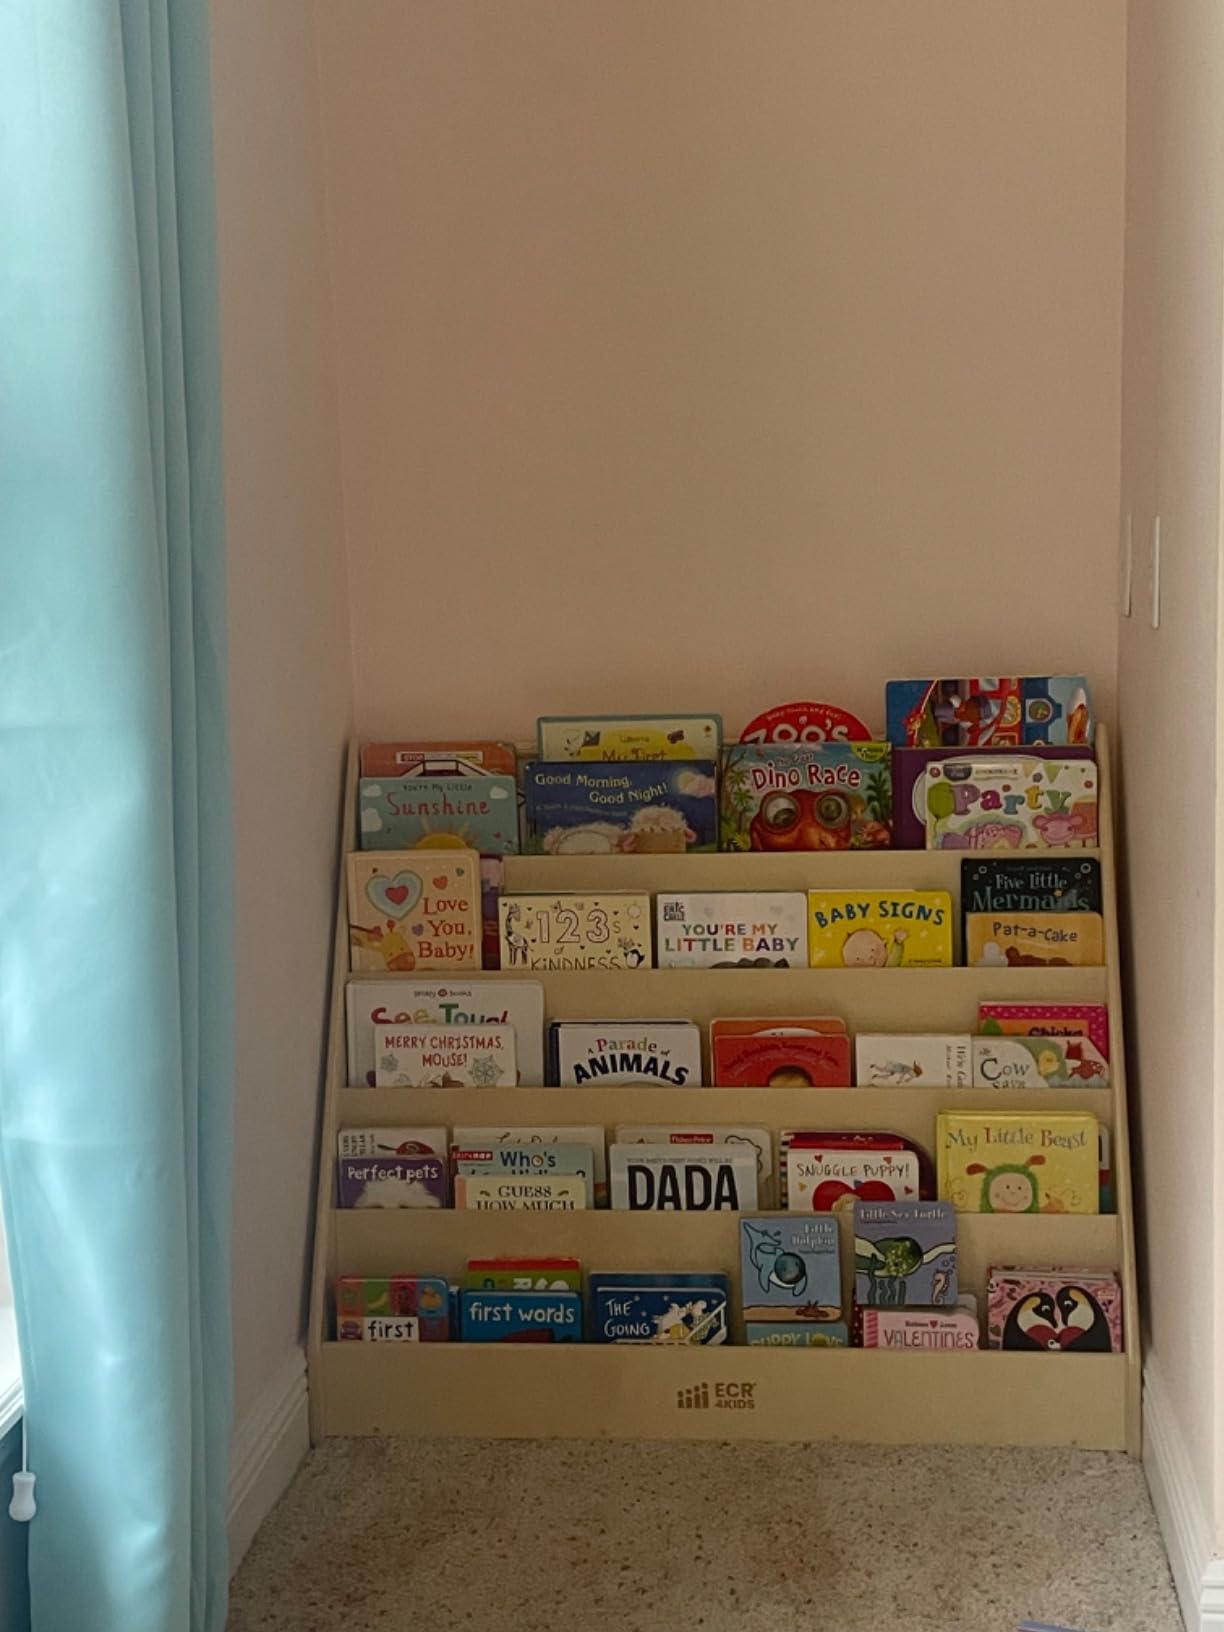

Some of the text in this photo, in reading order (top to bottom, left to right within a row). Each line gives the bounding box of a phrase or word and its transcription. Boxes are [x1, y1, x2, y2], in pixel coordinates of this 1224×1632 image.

[535, 773, 571, 786] Good
[752, 762, 861, 790] Dino Race
[589, 782, 669, 804] Good Night!
[386, 792, 490, 816] Sunshine
[994, 872, 1069, 889] Five Little
[422, 897, 469, 915] Love
[814, 900, 945, 928] BABY SIGNS
[682, 923, 778, 936] YOU'RE MY
[993, 921, 1079, 943] Pat-a-Cake
[417, 941, 474, 961] Baby!
[664, 937, 799, 952] LITTLE BABY
[384, 1035, 427, 1049] MERRY
[595, 1037, 657, 1052] Parade
[422, 1053, 468, 1067] MOUSE!
[573, 1053, 689, 1086] ANIMALS
[947, 1127, 1087, 1151] My Little Beast
[500, 1151, 557, 1168] Who's
[347, 1164, 439, 1184] Perfect pets
[796, 1163, 910, 1178] SNUGGLE PUPPY!
[498, 1185, 552, 1198] GUESS
[627, 1164, 739, 1211] DADA
[469, 1302, 575, 1324] first words
[605, 1299, 633, 1317] THE
[367, 1320, 414, 1338] first
[604, 1319, 650, 1337] GOING
[884, 1330, 974, 1348] VALENTINES
[714, 1382, 753, 1398] ECR
[714, 1399, 755, 1409] 4KIDS
